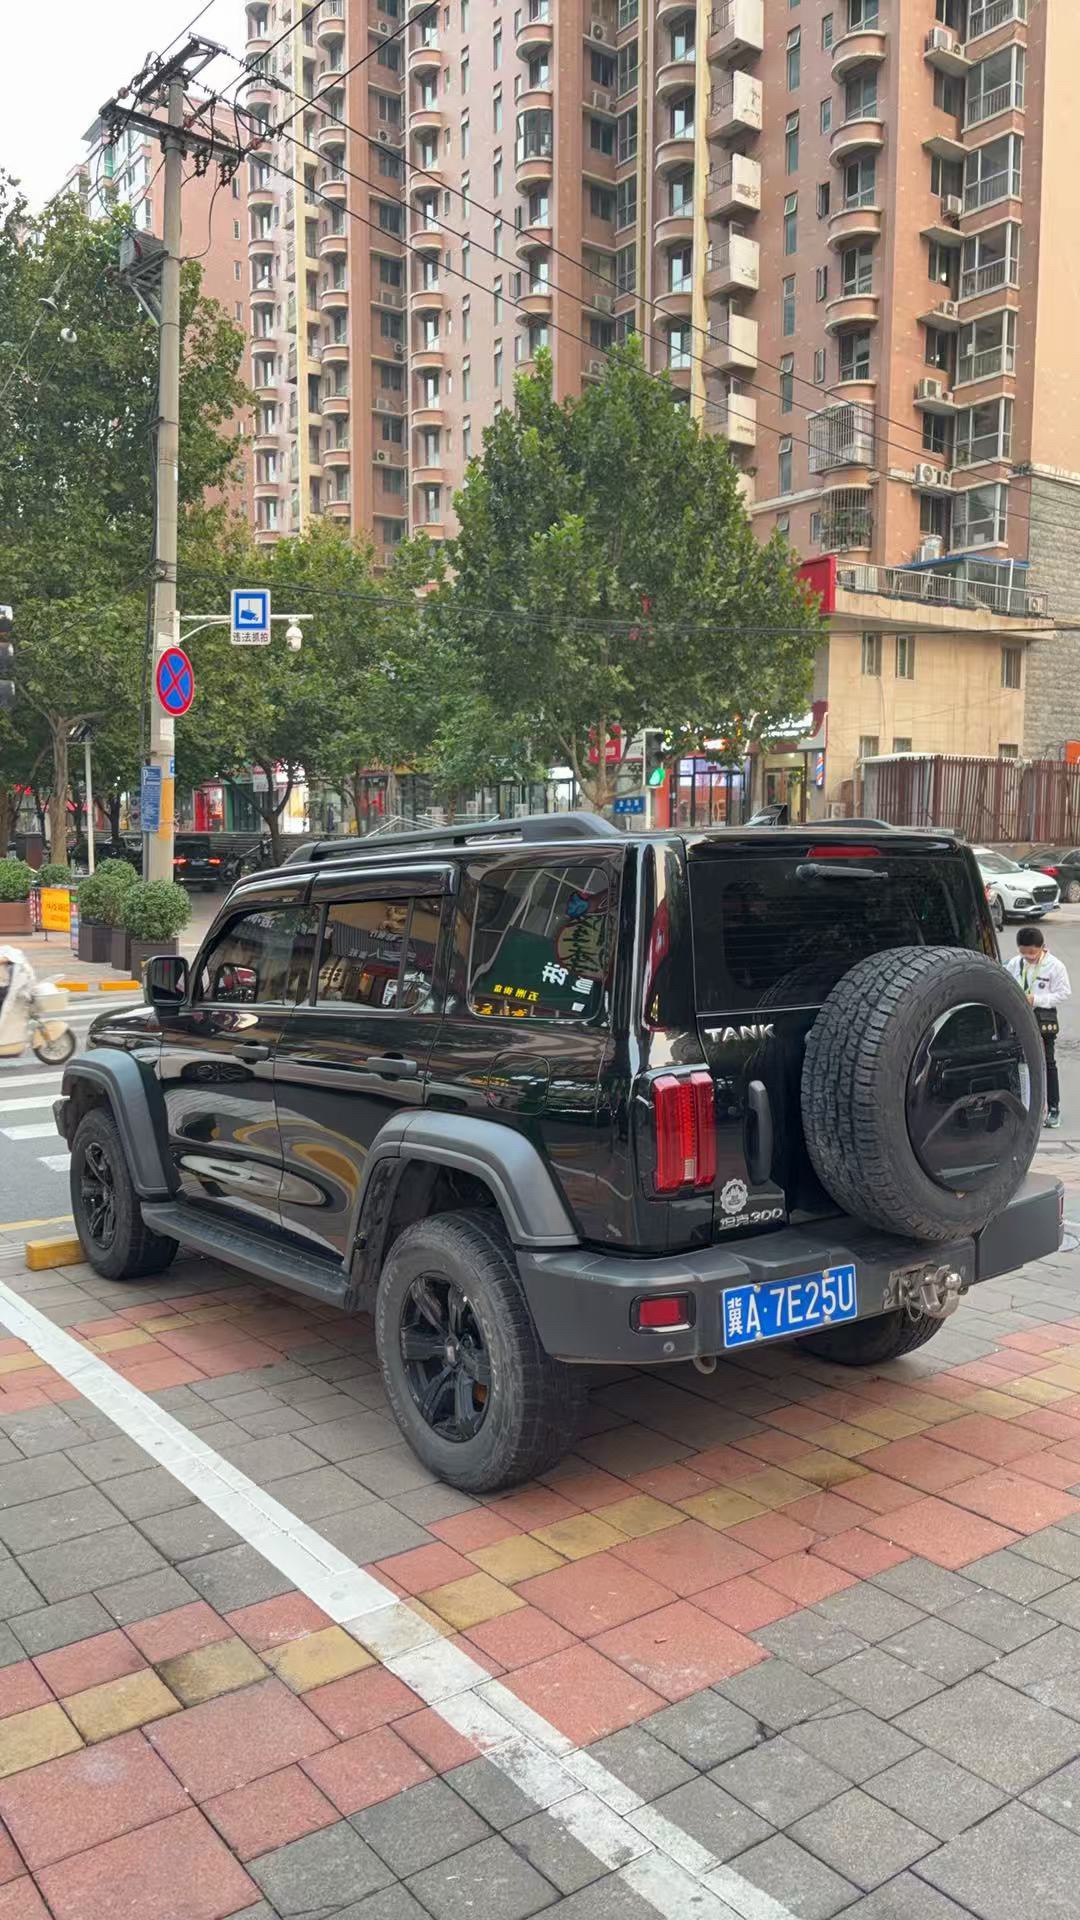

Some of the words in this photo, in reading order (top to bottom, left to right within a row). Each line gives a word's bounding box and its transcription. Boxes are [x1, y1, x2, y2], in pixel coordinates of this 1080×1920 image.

[232, 632, 269, 642] 违法抓拍
[704, 1023, 776, 1042] TANK
[719, 1207, 783, 1231] 坦克300
